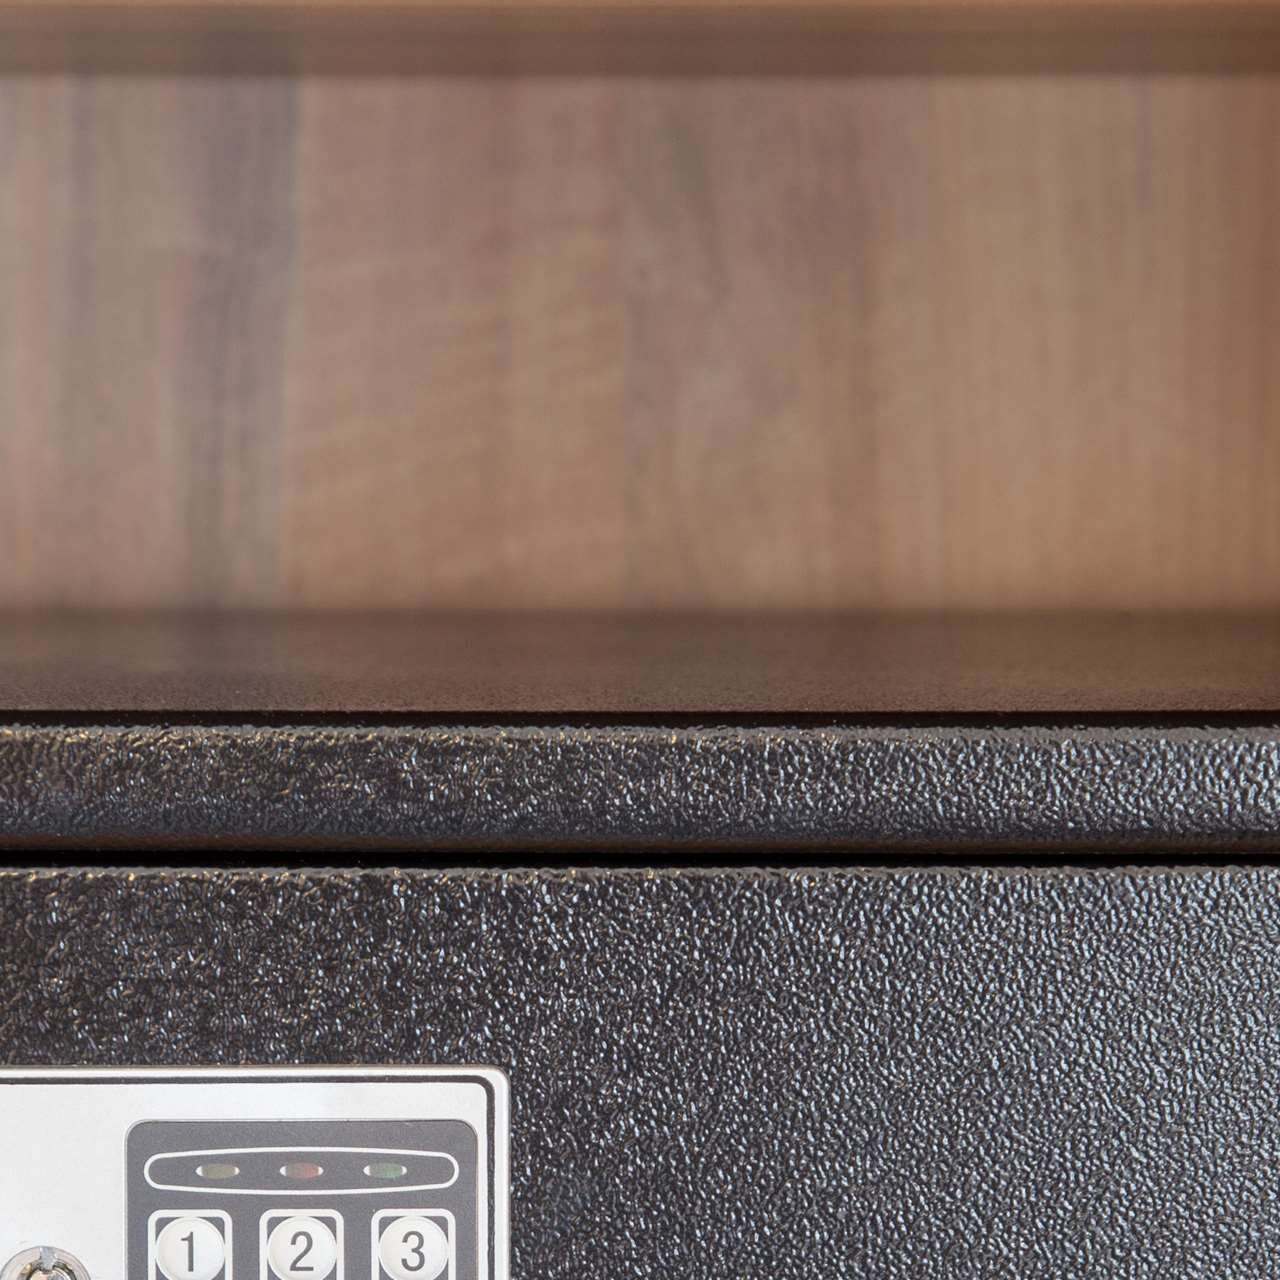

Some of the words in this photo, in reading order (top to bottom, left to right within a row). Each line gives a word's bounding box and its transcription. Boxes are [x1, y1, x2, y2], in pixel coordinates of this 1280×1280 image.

[179, 1231, 195, 1273] 1
[288, 1231, 315, 1273] 2
[400, 1230, 426, 1273] 3
